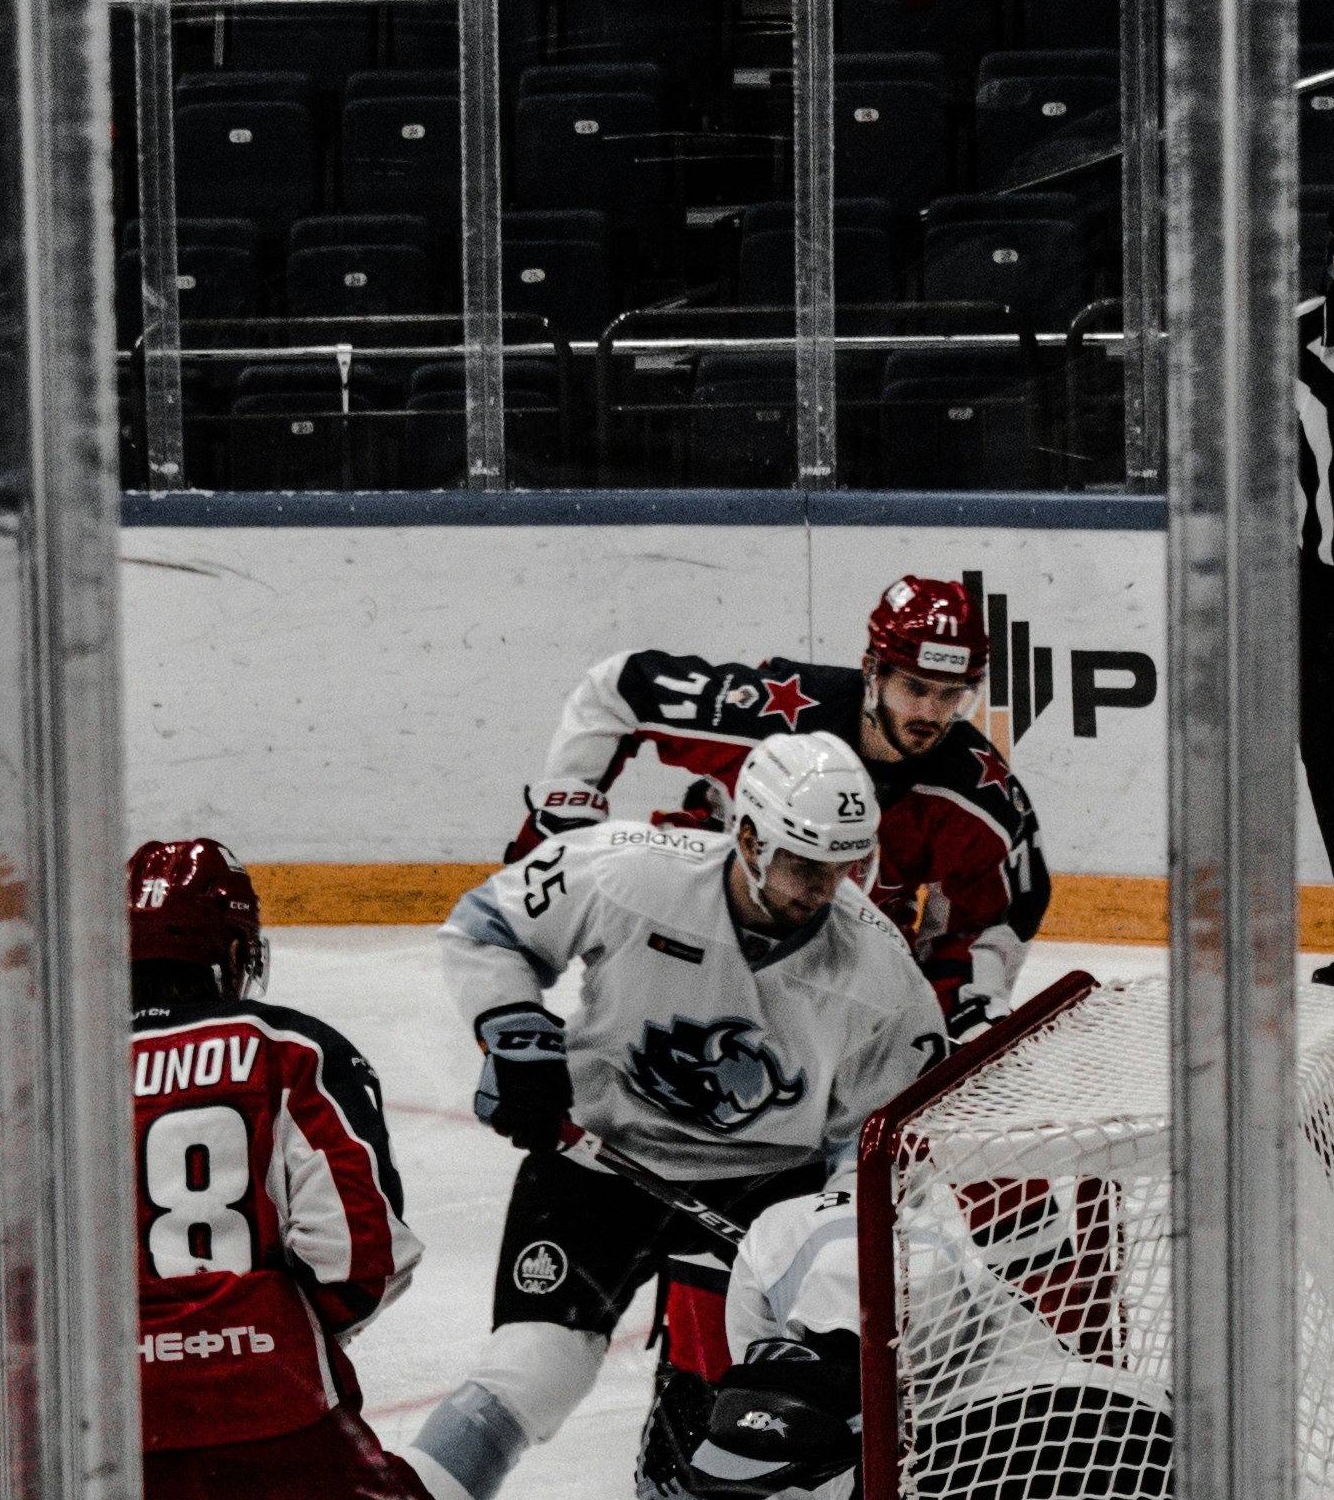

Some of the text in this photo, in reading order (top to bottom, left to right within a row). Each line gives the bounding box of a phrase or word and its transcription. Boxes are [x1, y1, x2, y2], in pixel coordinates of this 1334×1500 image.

[934, 613, 959, 638] 71
[837, 792, 866, 817] 25
[610, 829, 707, 854] Belavia
[524, 845, 568, 920] 25
